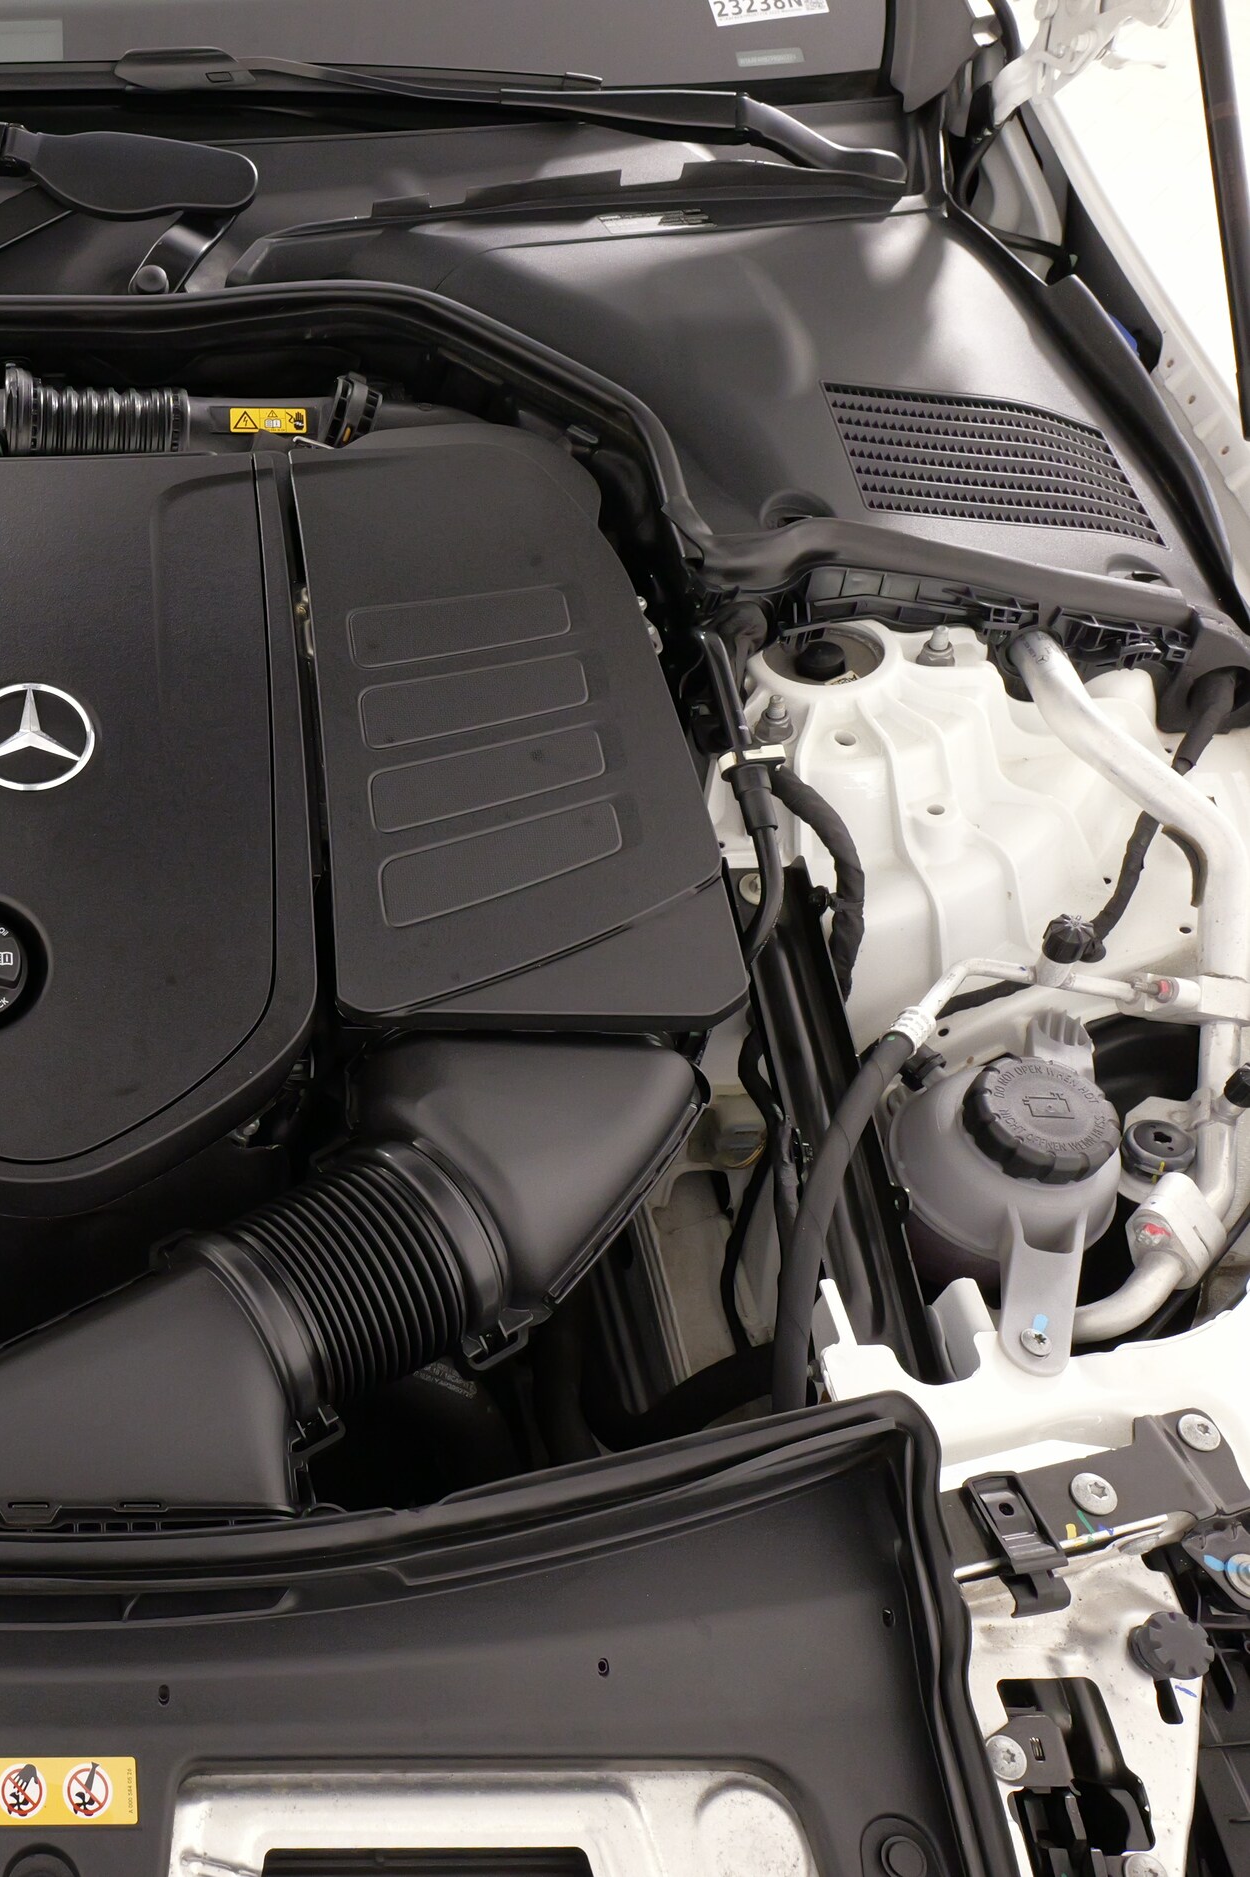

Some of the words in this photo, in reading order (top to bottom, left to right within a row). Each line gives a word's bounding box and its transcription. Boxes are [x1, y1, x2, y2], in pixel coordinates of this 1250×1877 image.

[1015, 1066, 1042, 1075] OPEN
[999, 1072, 1015, 1086] NOT
[994, 1085, 1005, 1098] DO
[1078, 1087, 1099, 1104] HOT
[999, 1109, 1026, 1133] NICHT
